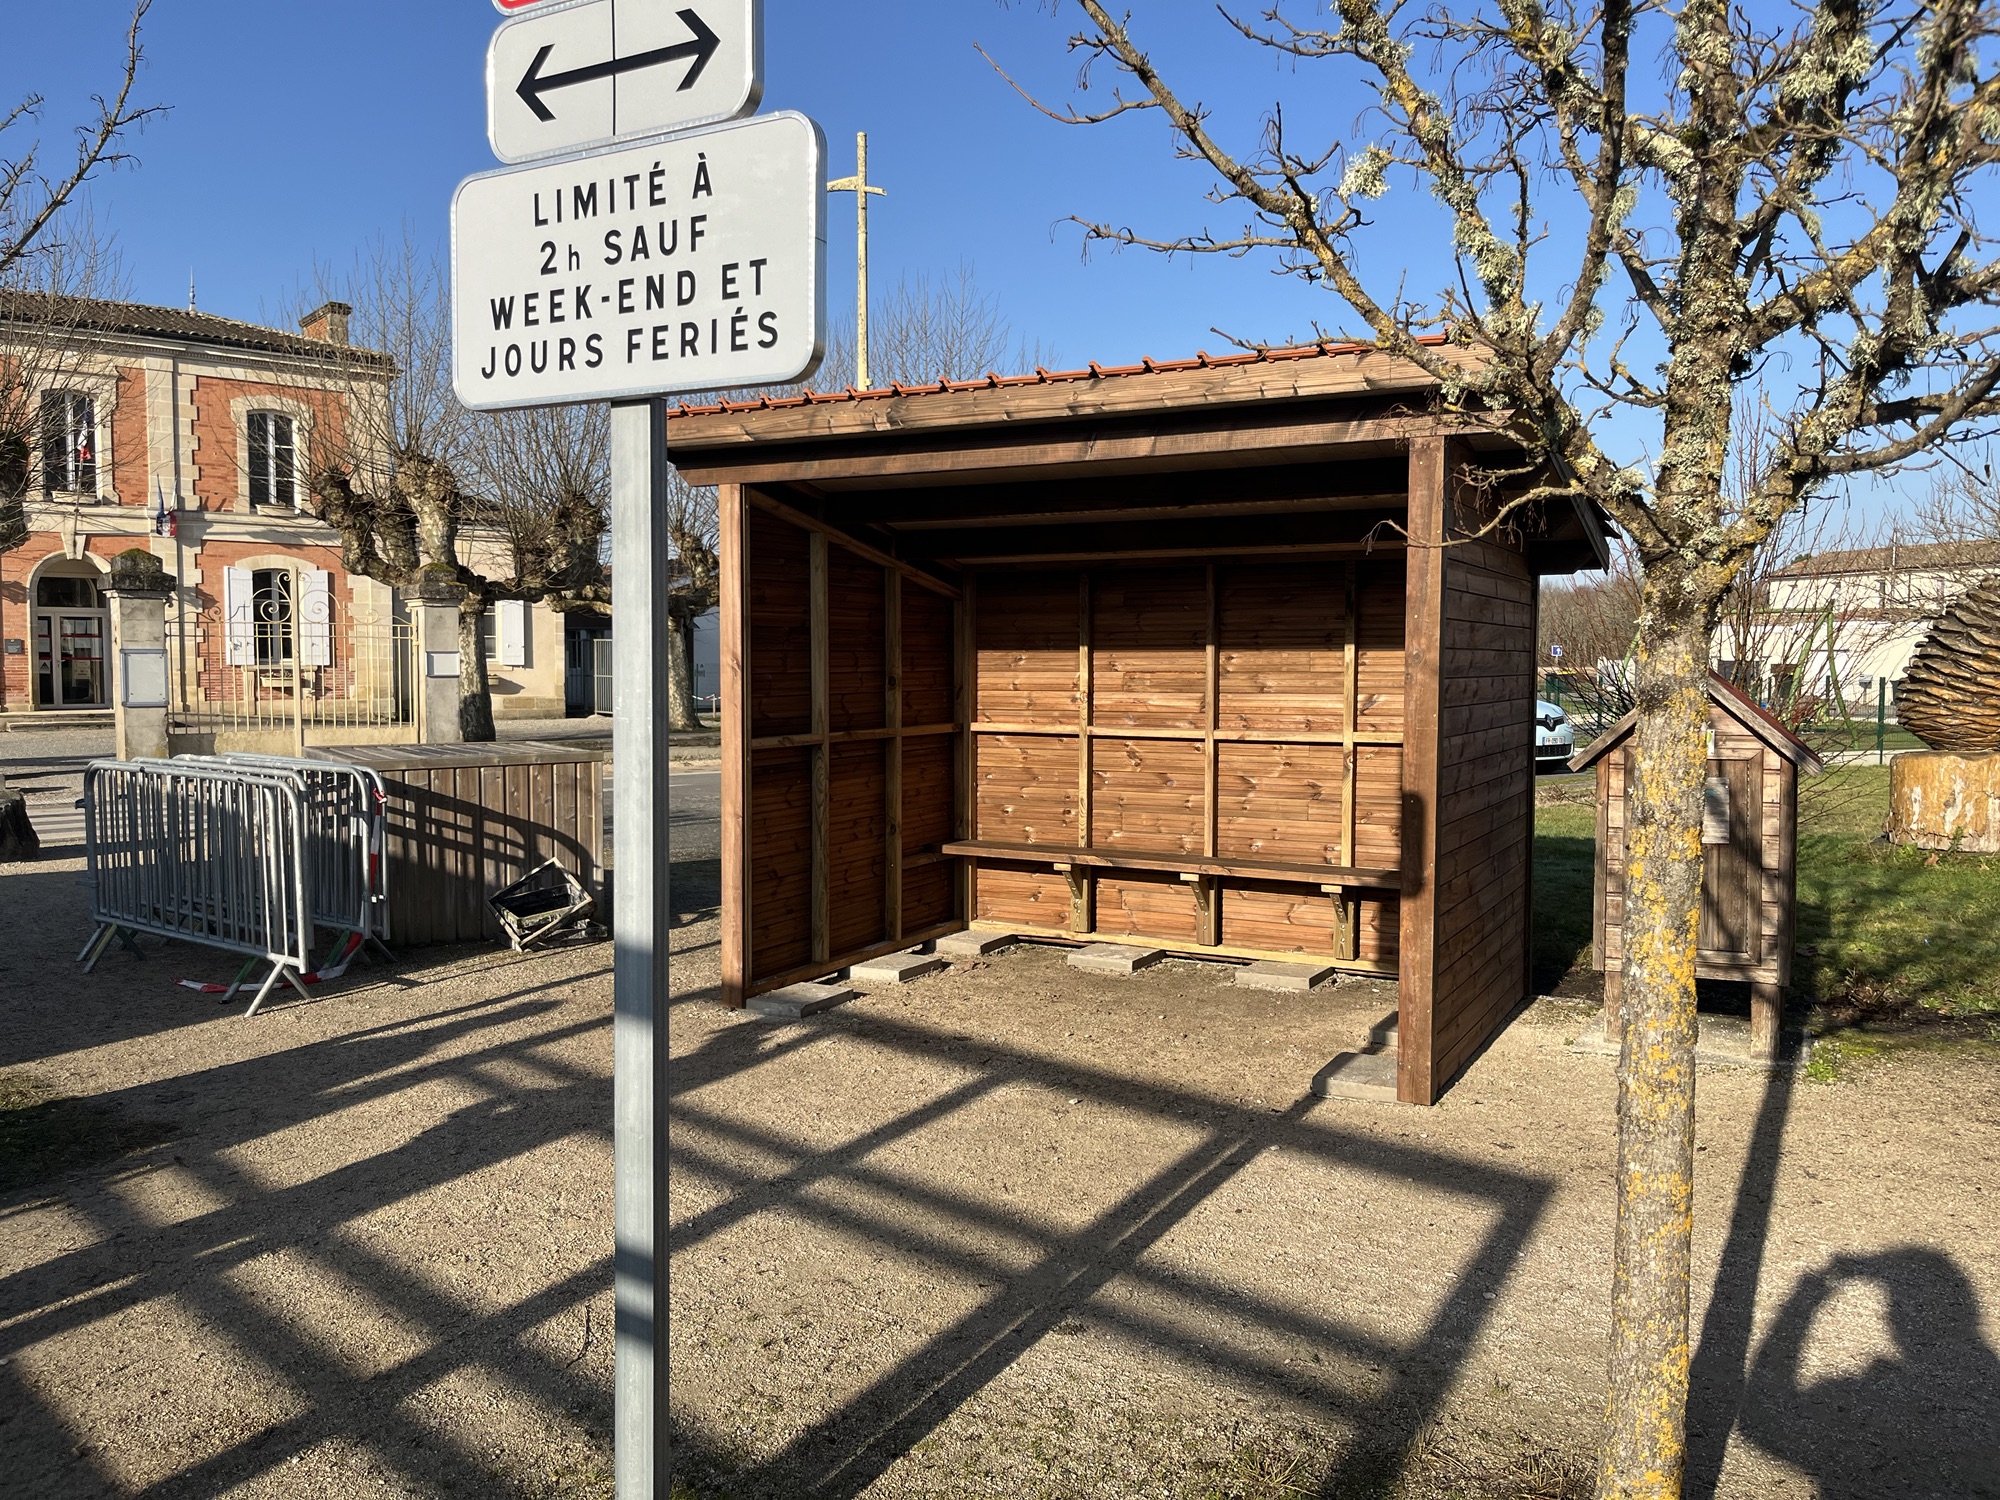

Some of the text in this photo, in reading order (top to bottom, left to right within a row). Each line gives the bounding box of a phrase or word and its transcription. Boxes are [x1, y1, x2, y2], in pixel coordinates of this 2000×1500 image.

[533, 152, 713, 227] LIMITÉ À
[540, 213, 708, 276] 2h SAUF
[490, 257, 768, 331] WEEK-END ET
[481, 306, 779, 380] JOURS FERIÉS
